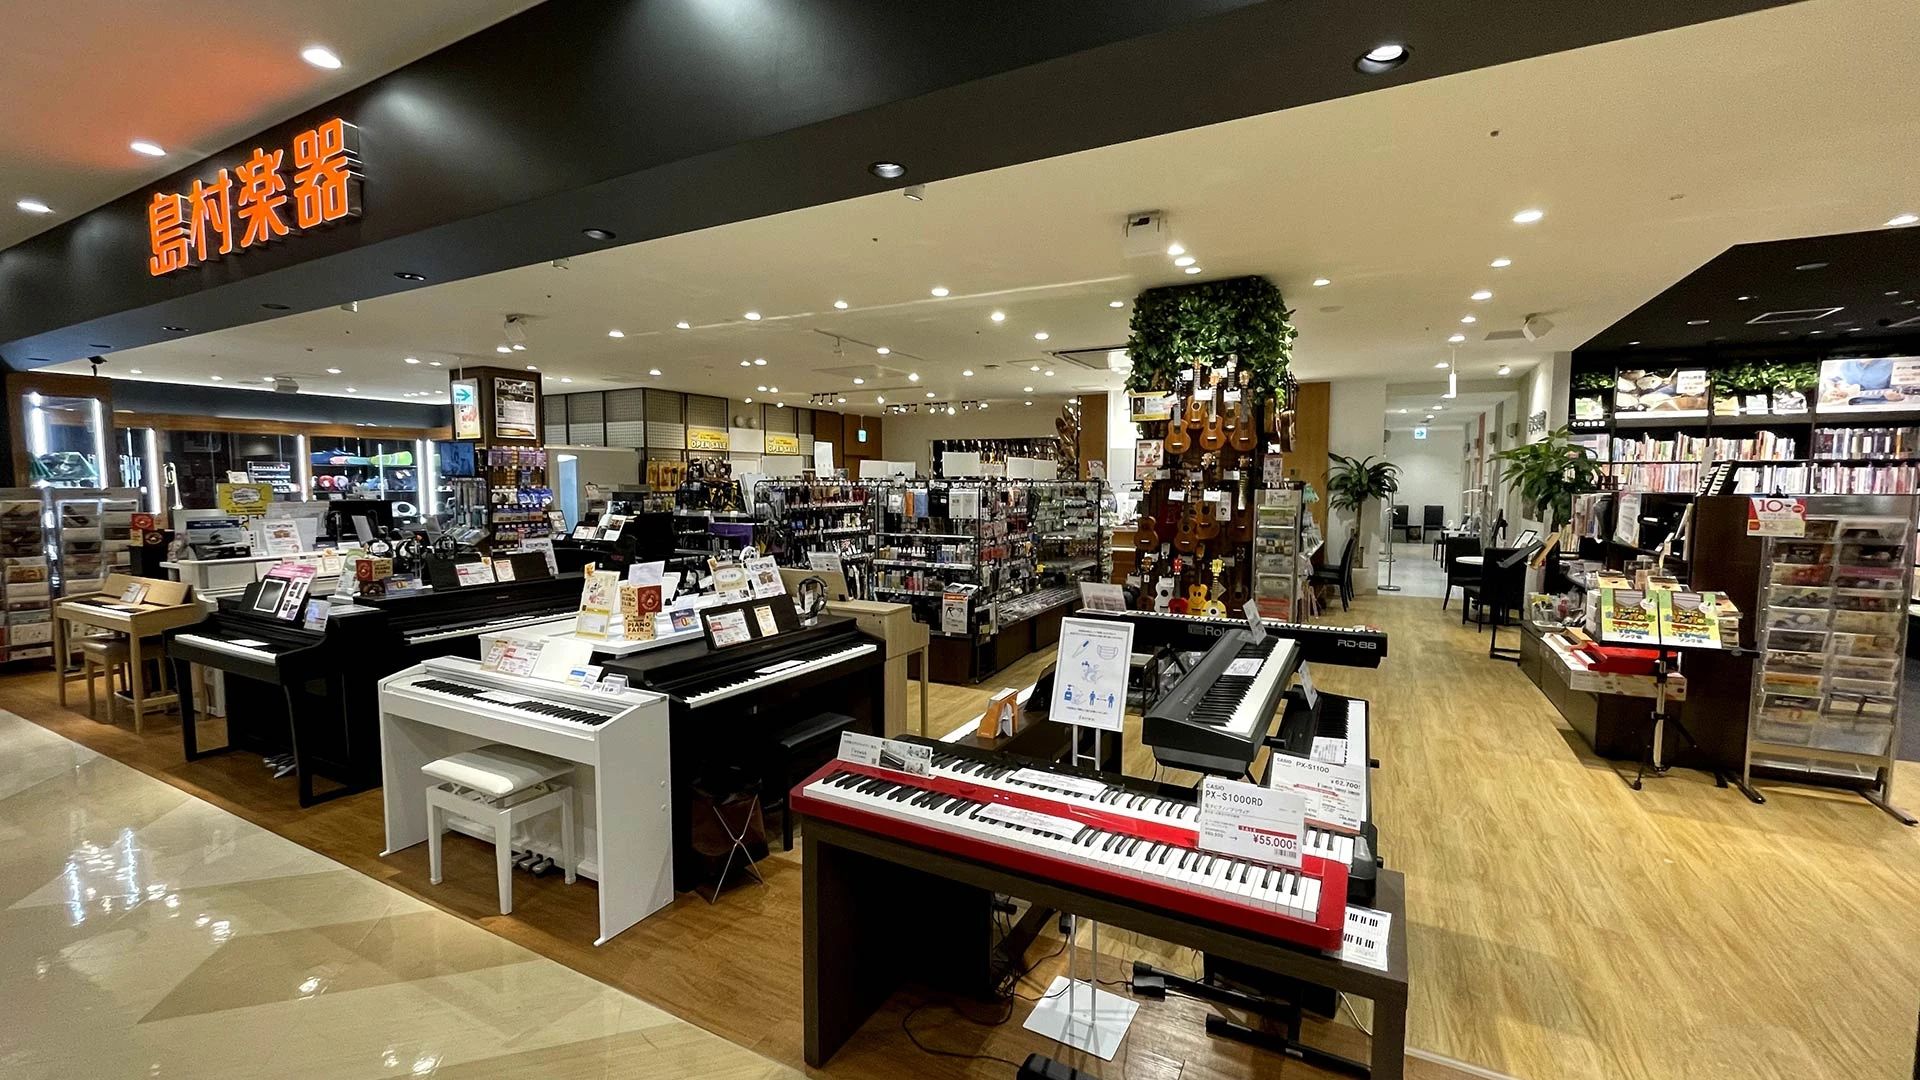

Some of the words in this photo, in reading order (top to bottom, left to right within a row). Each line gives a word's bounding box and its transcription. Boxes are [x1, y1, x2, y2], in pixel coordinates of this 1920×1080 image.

[148, 117, 352, 277] 島村楽器
[692, 440, 709, 449] OPEN
[710, 442, 728, 450] SALE
[768, 445, 783, 453] OPEN
[784, 446, 797, 454] SALE
[1337, 639, 1376, 649] RD-88
[1277, 757, 1293, 765] CASIO
[1296, 761, 1330, 773] PX-S1100
[1205, 783, 1225, 791] CASIO
[1205, 789, 1263, 807] PX-S1000RD
